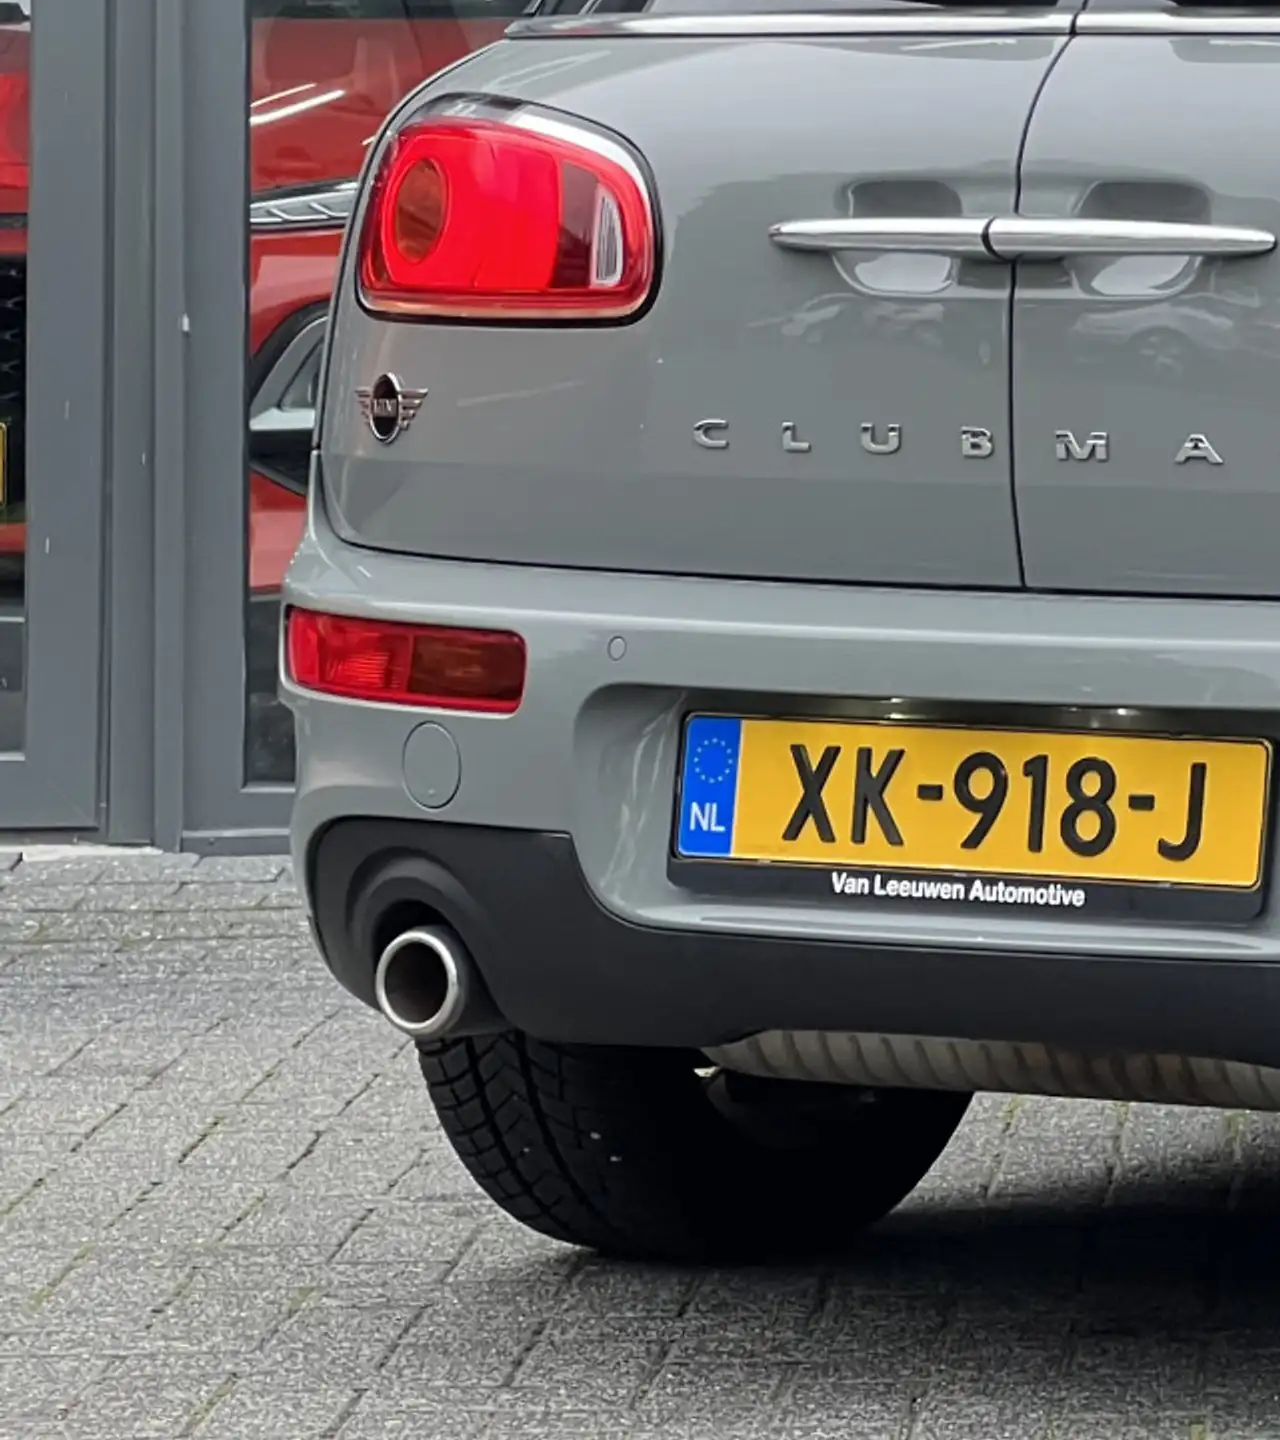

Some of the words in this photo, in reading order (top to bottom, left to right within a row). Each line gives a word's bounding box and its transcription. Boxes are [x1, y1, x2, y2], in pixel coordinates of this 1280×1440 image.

[689, 801, 726, 833] NL
[781, 743, 1208, 862] XK-918-J
[831, 871, 869, 895] Van
[873, 874, 966, 901] Leeuwen
[968, 879, 1086, 907] Automotive
